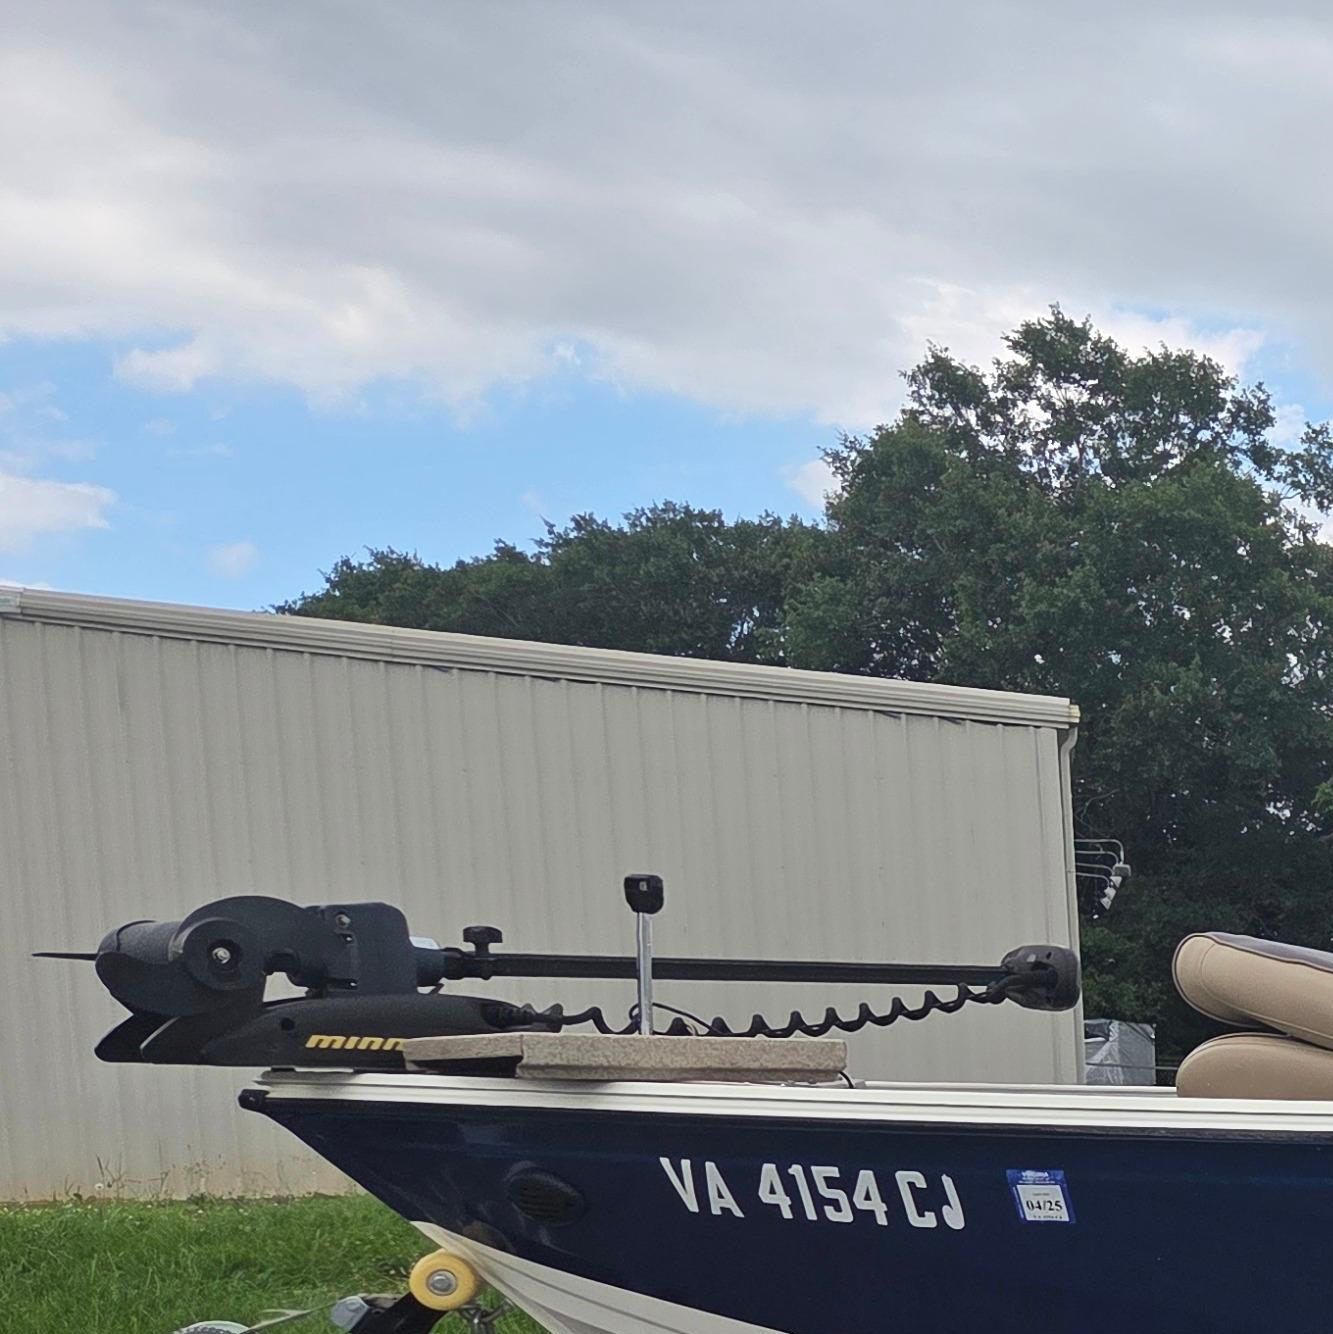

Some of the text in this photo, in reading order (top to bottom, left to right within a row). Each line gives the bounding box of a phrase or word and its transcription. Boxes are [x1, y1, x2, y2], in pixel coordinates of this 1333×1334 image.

[659, 1156, 966, 1230] VA 4154 CJ
[1025, 1200, 1063, 1212] 04/25
